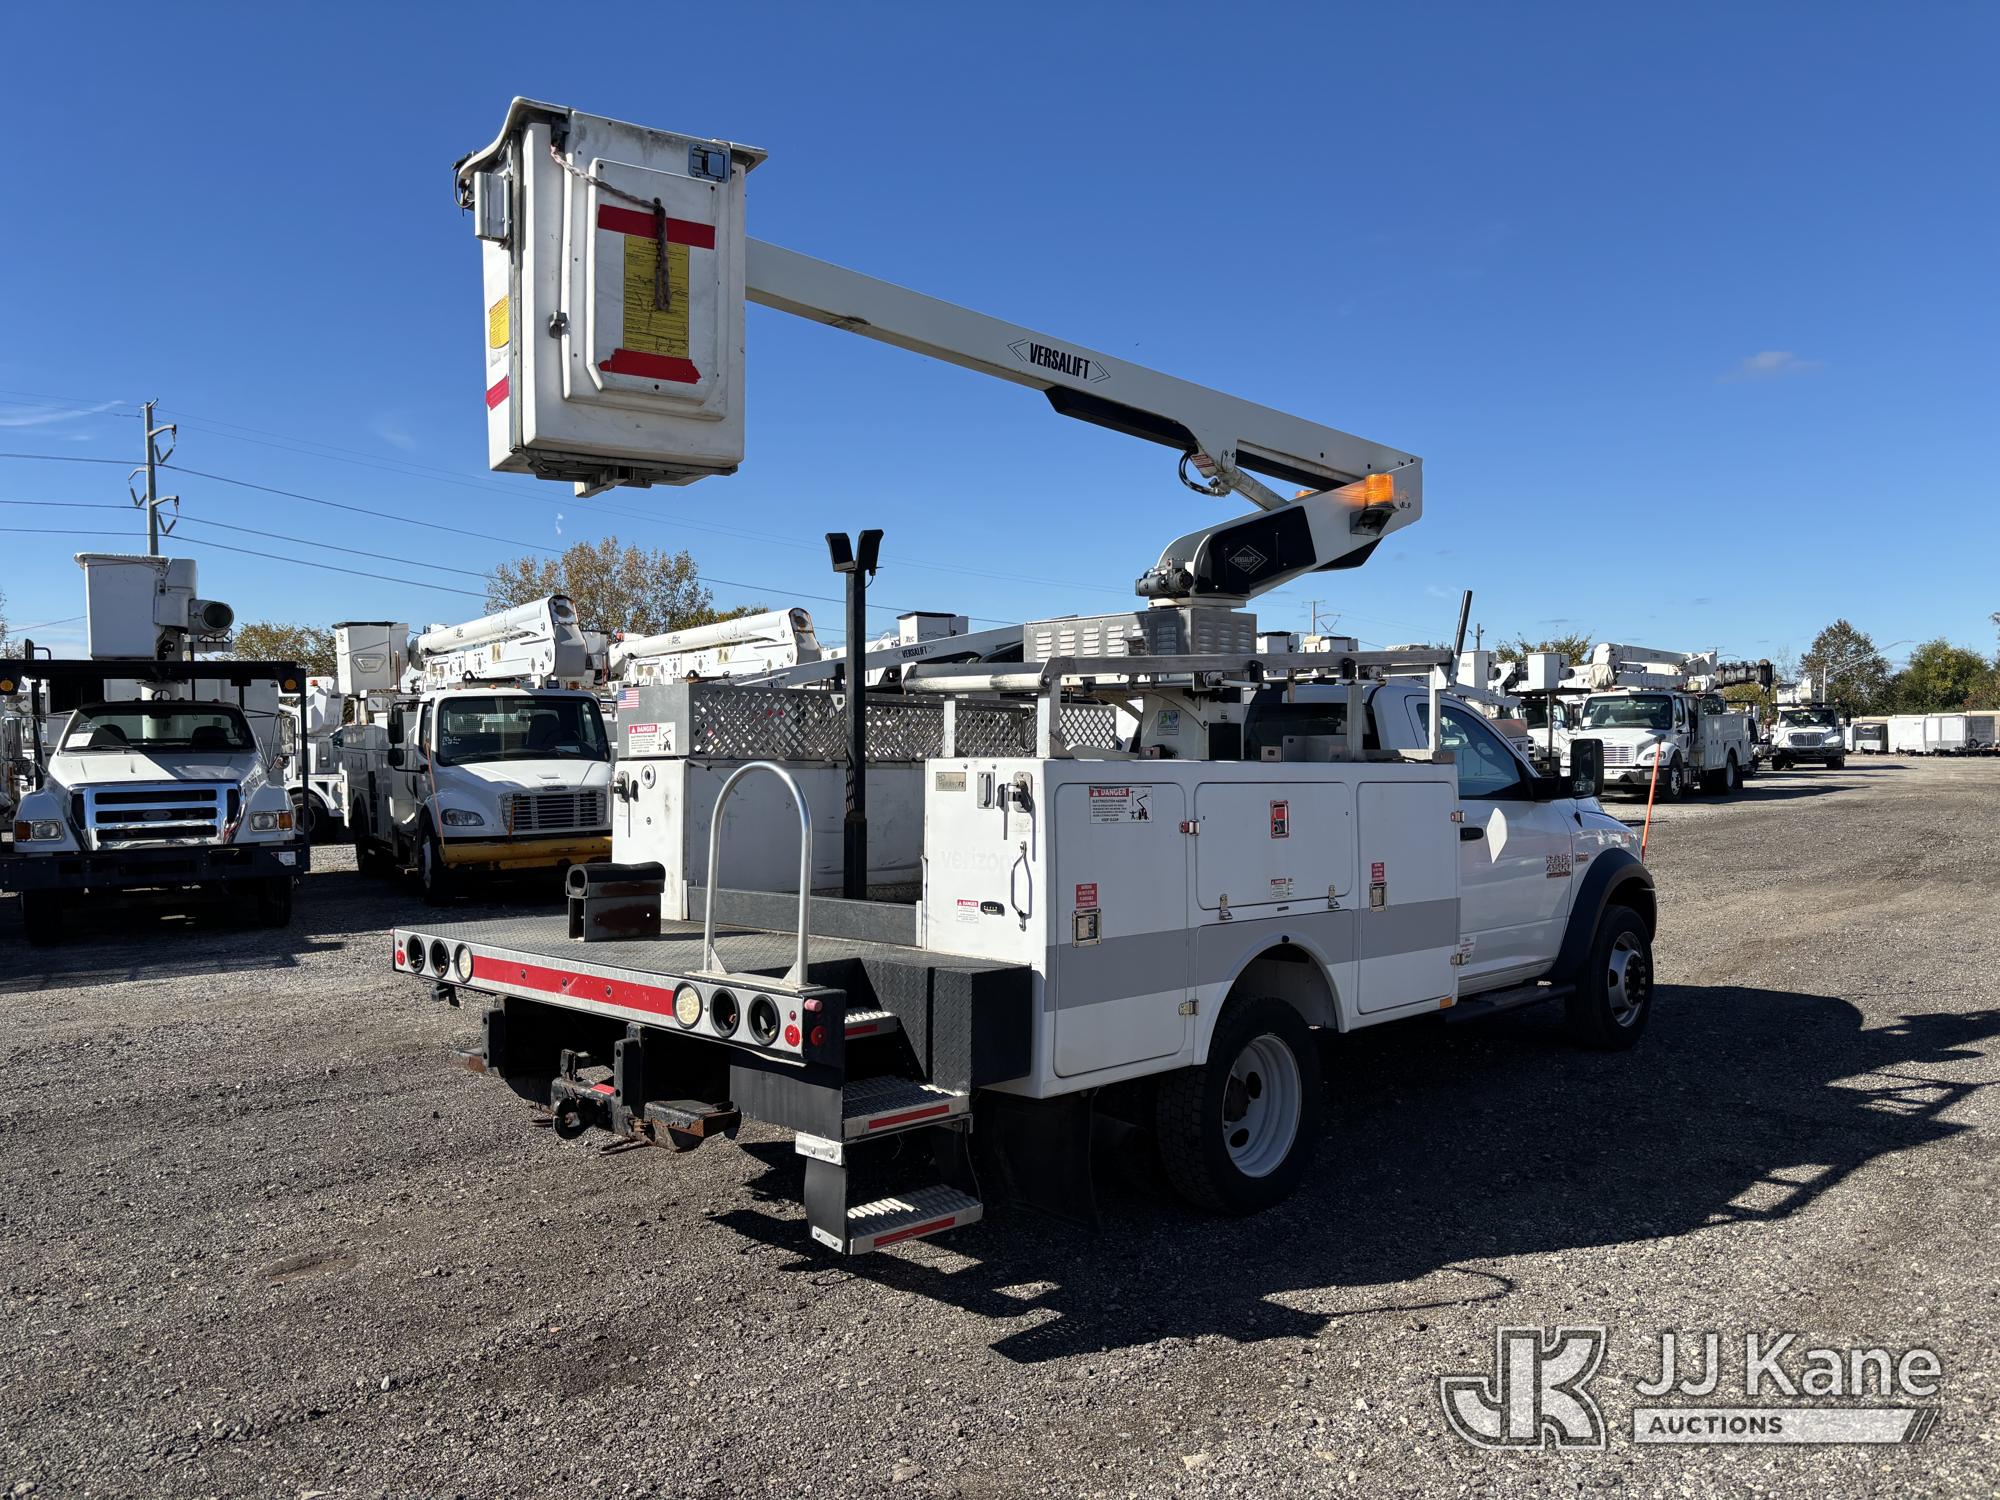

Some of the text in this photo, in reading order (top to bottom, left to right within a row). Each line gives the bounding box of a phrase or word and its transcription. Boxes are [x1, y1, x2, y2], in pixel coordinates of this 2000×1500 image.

[1030, 342, 1091, 380] VERSALIFT
[901, 645, 928, 659] VERSALIFT
[636, 725, 656, 733] DANGER
[1100, 788, 1127, 797] DANGER
